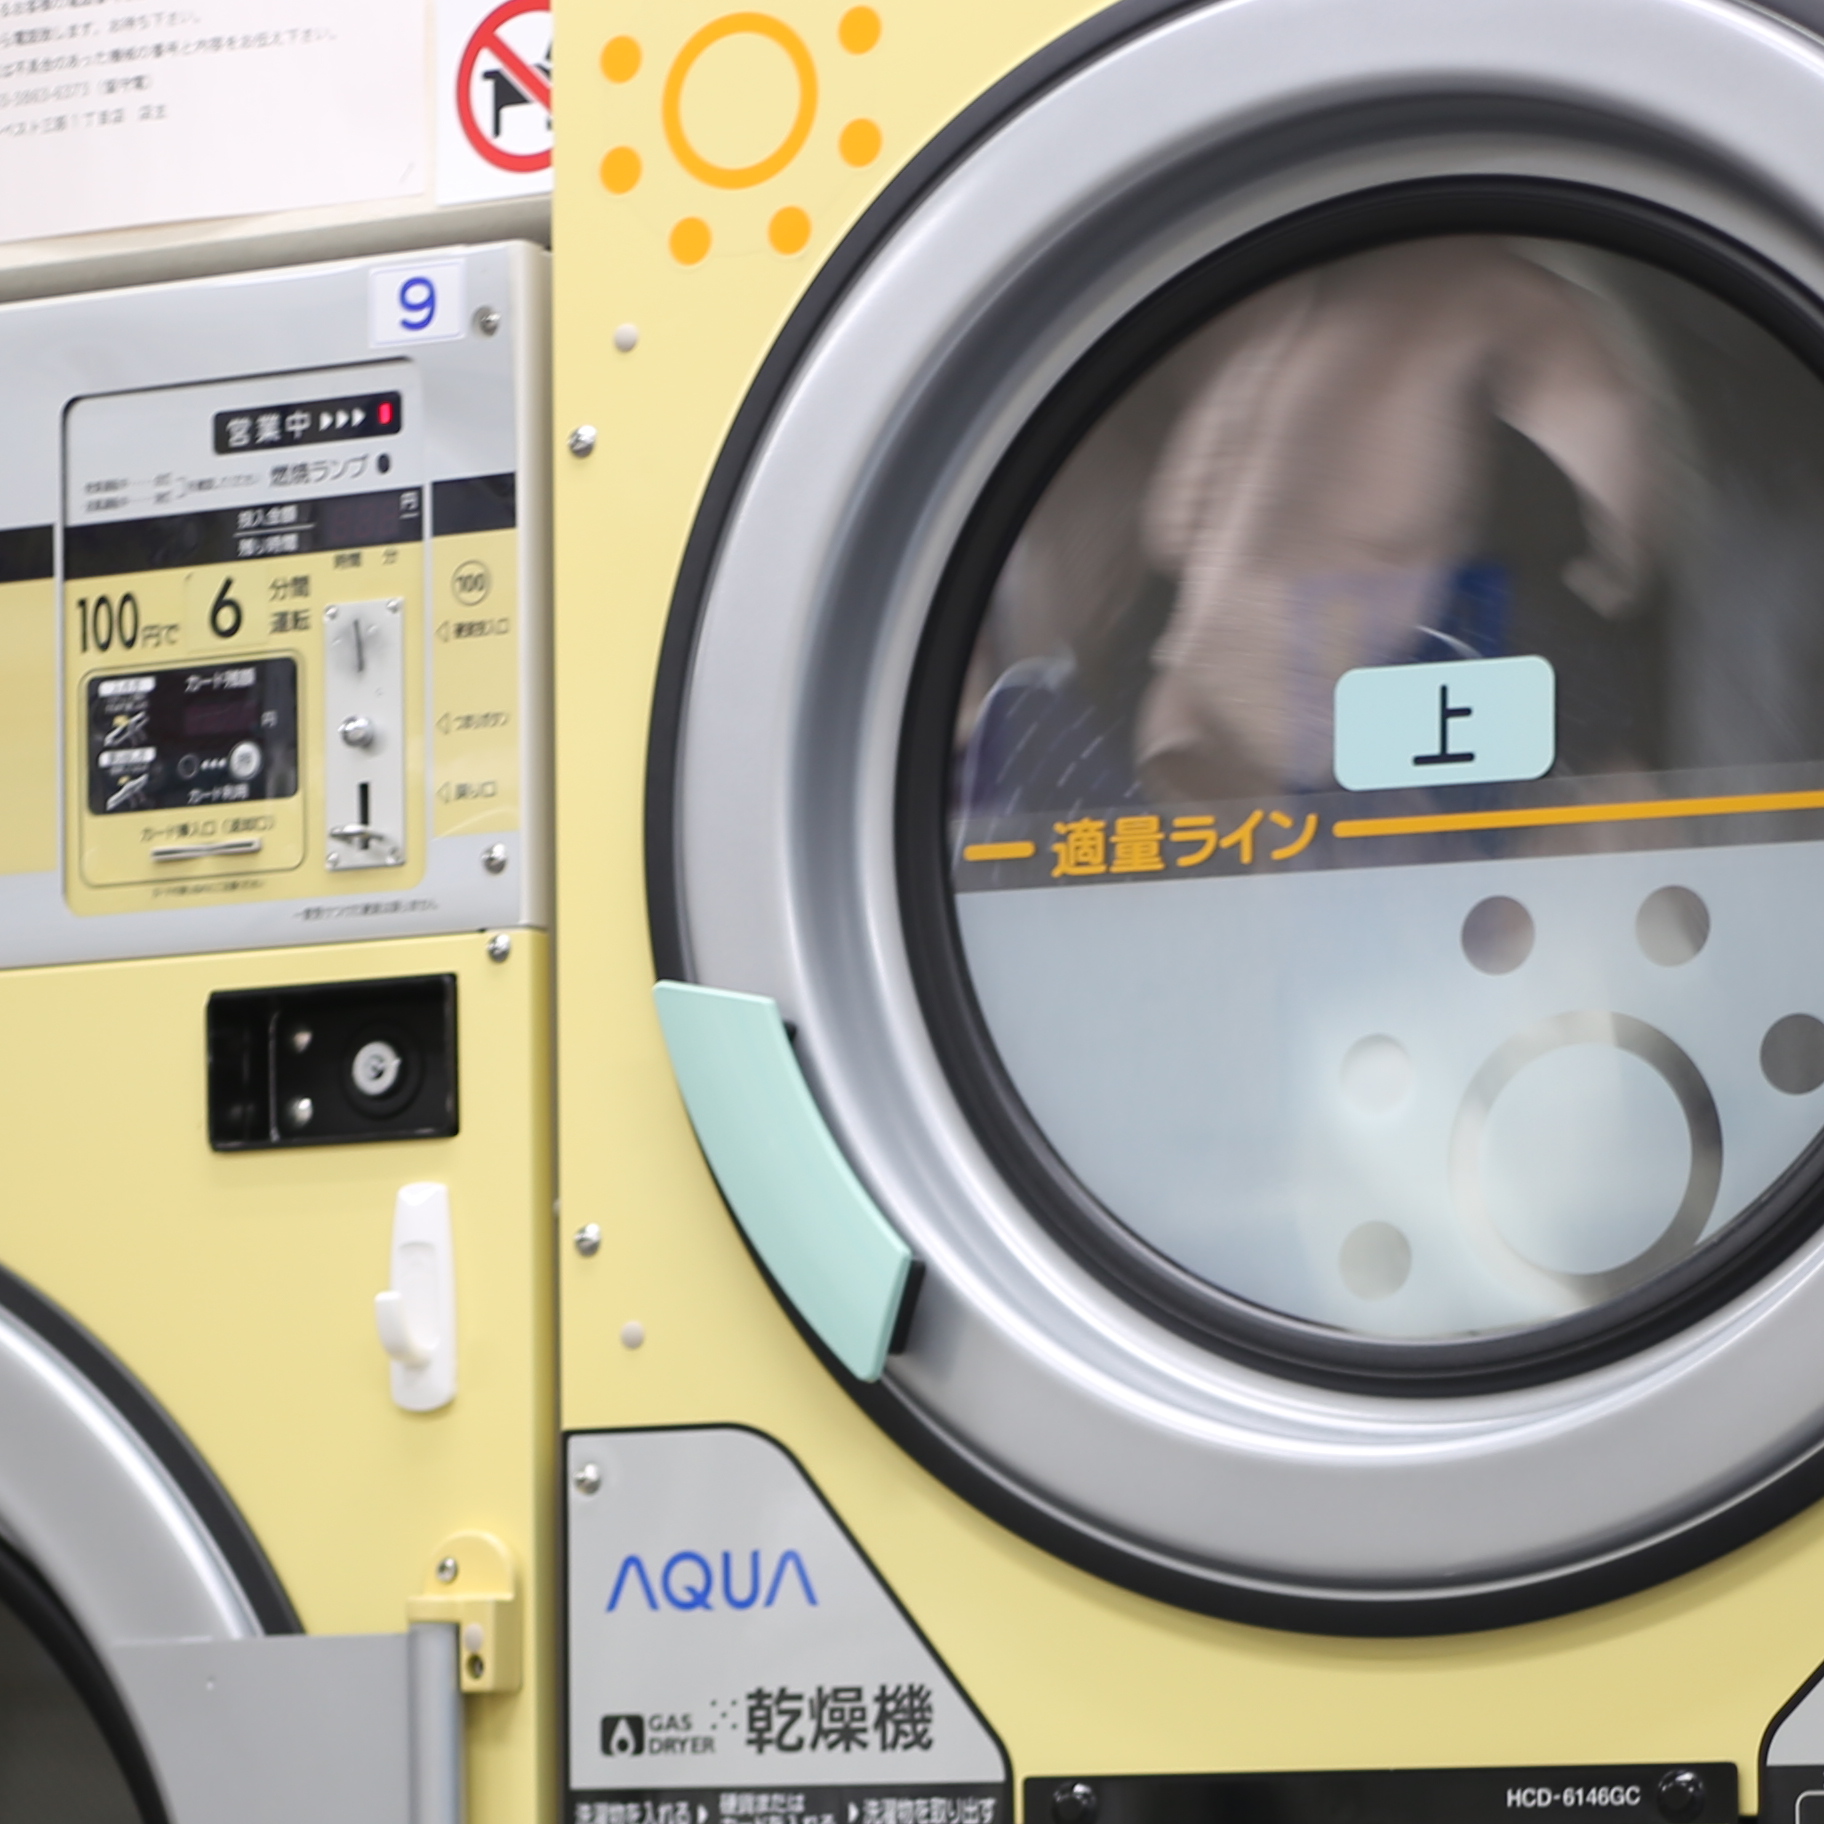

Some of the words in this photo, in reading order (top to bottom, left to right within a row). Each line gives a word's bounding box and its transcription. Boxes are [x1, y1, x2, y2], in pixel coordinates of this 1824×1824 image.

[399, 275, 438, 332] 9
[226, 410, 312, 449] 営業中
[269, 453, 368, 490] 燃焼ランプ
[209, 575, 243, 640] 6
[269, 575, 311, 601] 分間
[269, 609, 311, 636] 運転
[1411, 684, 1474, 766] 上
[1052, 810, 1319, 878] 適量ライン
[606, 1550, 818, 1613] AQUA
[648, 1714, 692, 1731] GAS
[746, 1685, 934, 1753] 乾燥機
[648, 1737, 715, 1755] DRYER
[1507, 1787, 1640, 1807] HCD-6146GC
